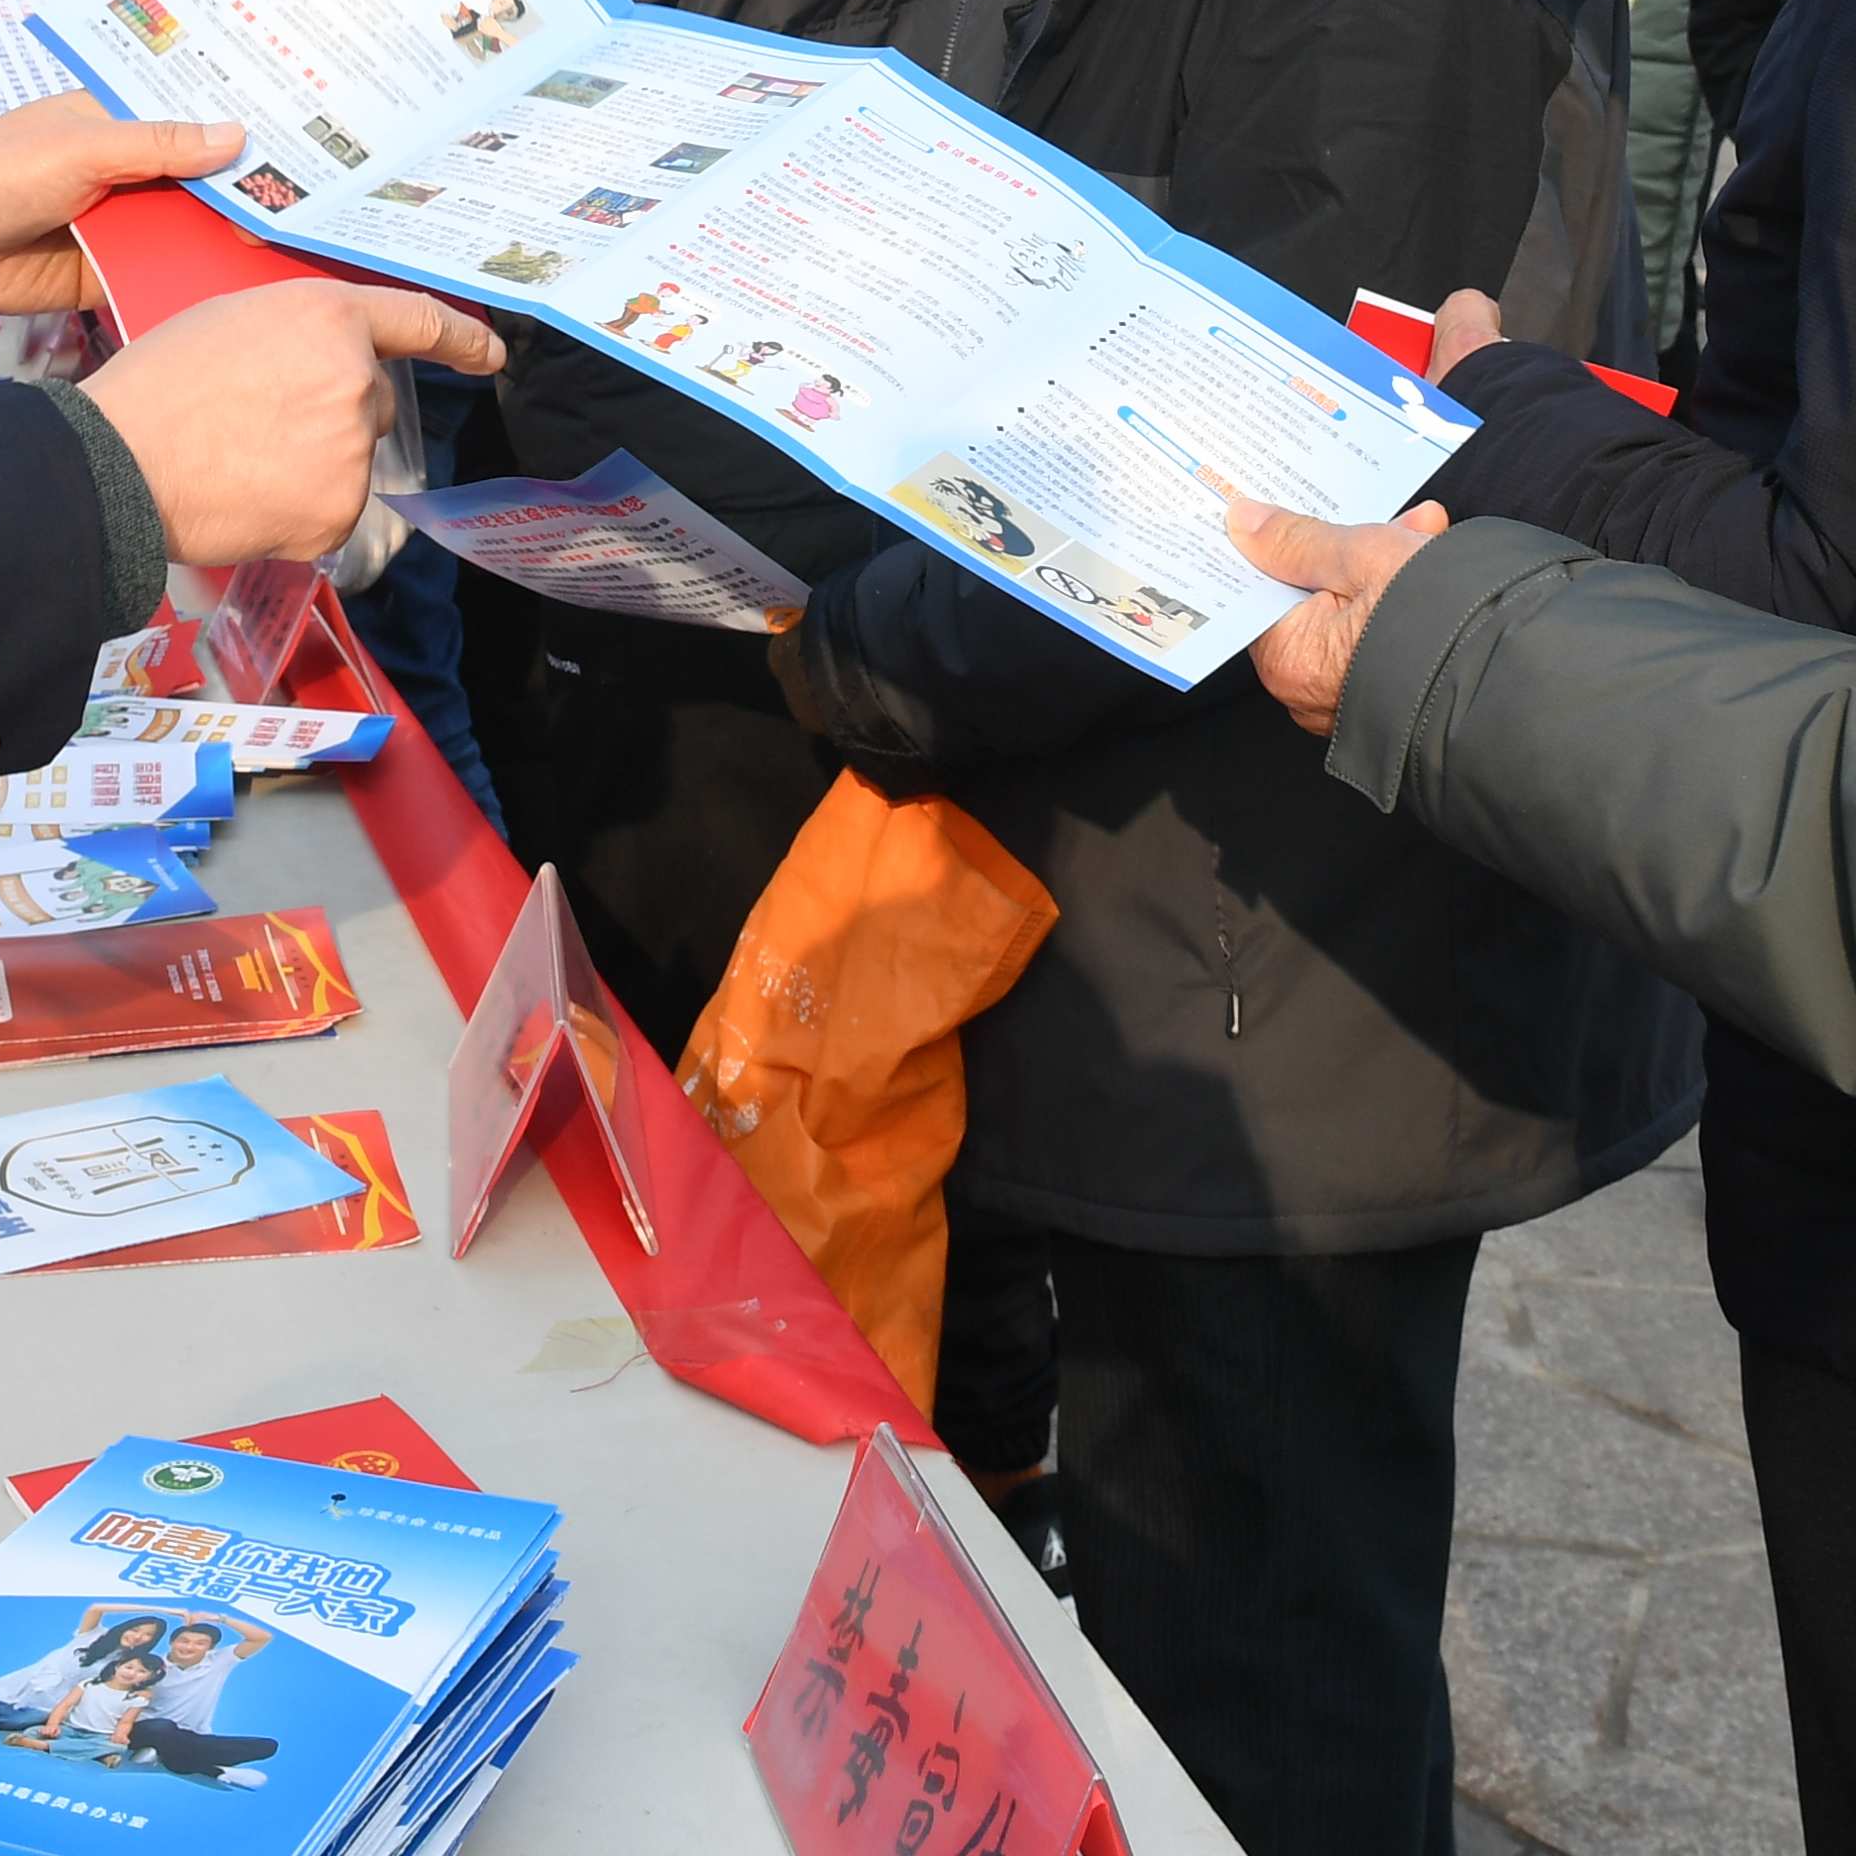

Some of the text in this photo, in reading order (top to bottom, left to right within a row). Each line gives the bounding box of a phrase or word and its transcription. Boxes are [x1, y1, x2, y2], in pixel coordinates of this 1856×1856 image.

[356, 1506, 504, 1542] 珍爱生命 远离毒品
[129, 1557, 395, 1632] 幸福一大家
